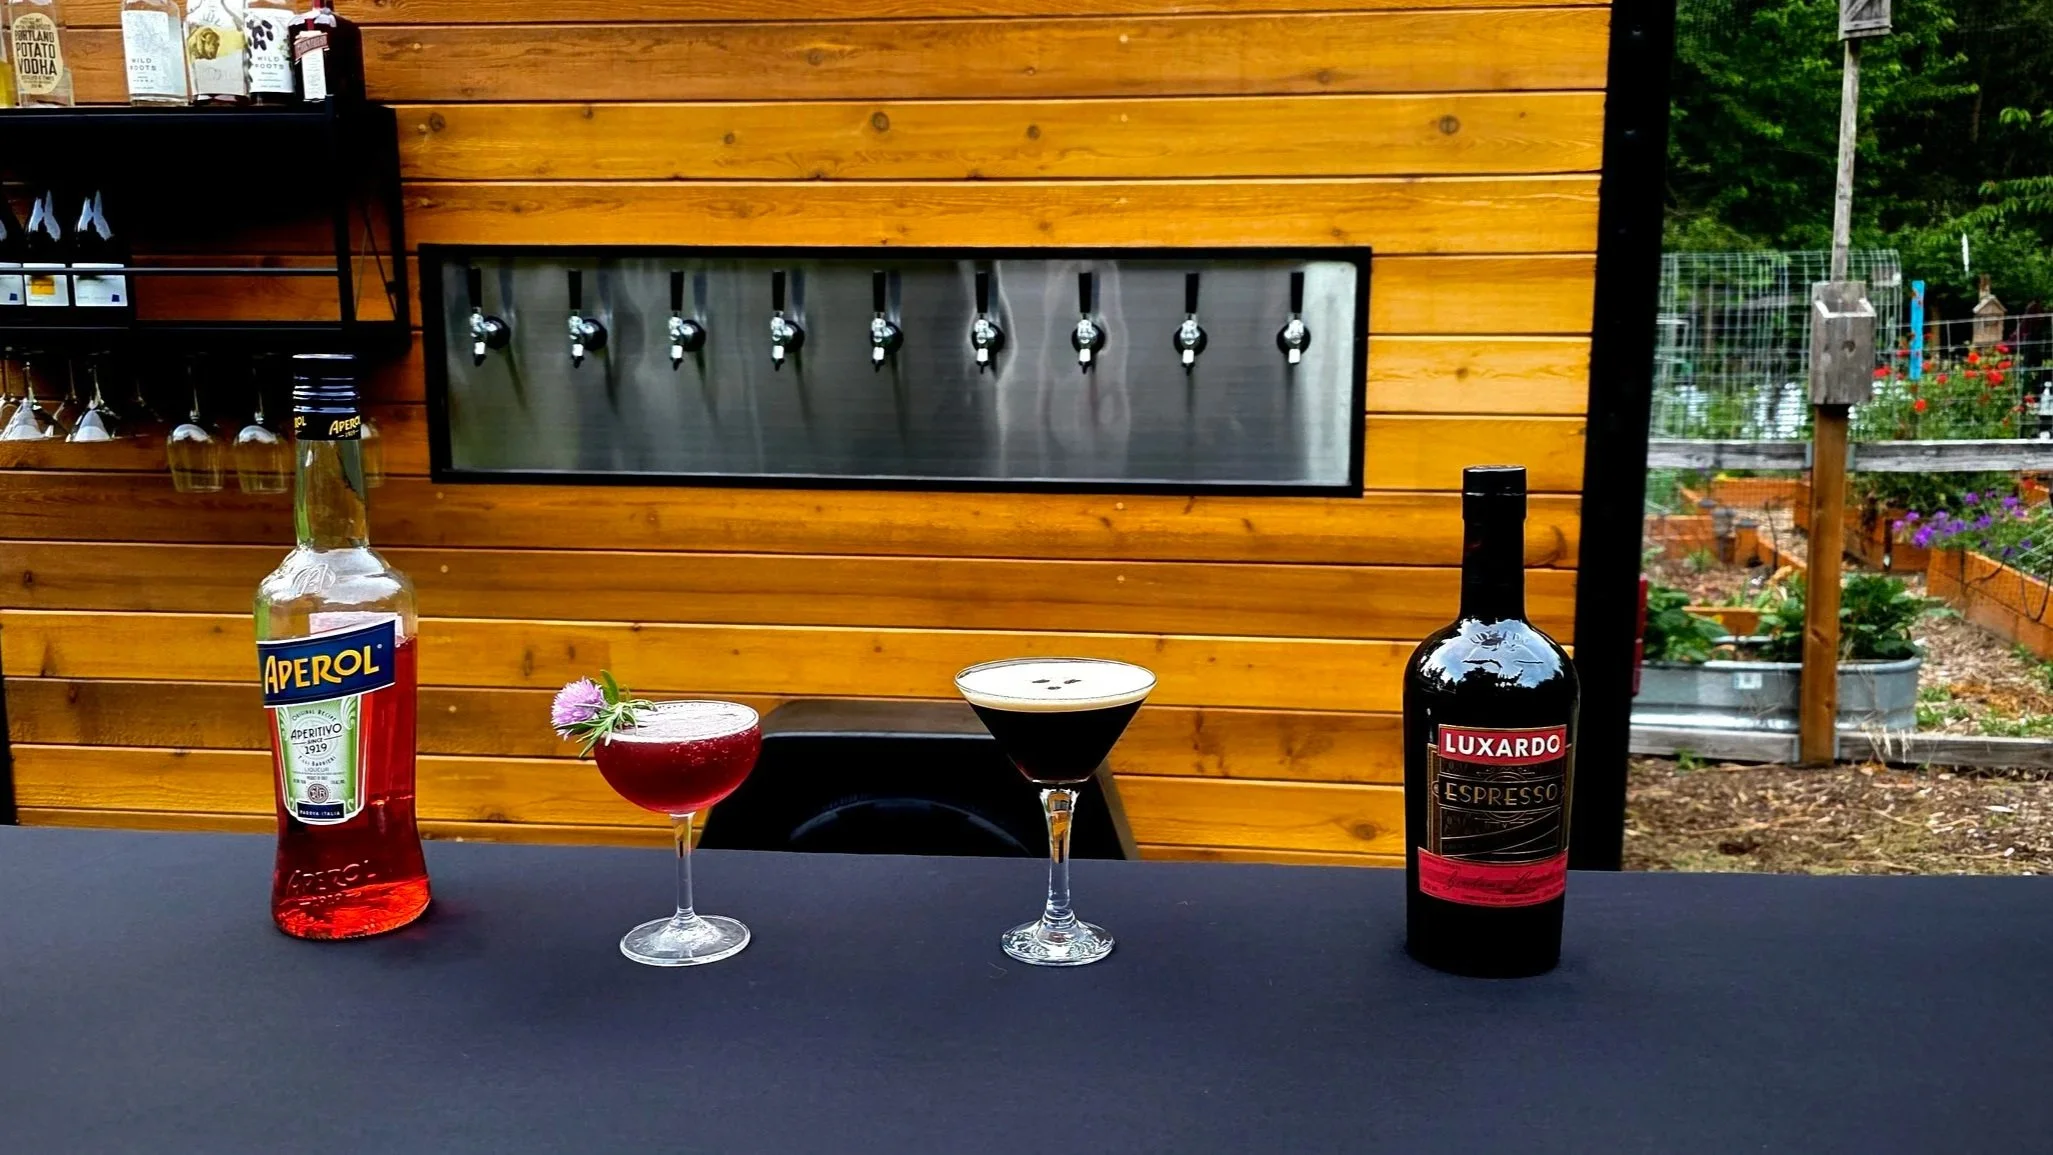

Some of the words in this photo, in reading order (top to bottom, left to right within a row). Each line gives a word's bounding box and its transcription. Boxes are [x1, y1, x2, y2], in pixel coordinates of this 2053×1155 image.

[14, 29, 55, 43] PORTLAND
[16, 42, 56, 59] POTATO
[265, 644, 380, 695] APEROL
[290, 722, 343, 741] APERITIVO
[304, 742, 328, 755] 1919
[307, 737, 323, 745] SINCE
[1445, 732, 1561, 758] LUXARDO
[1444, 781, 1559, 806] ESPRESSO
